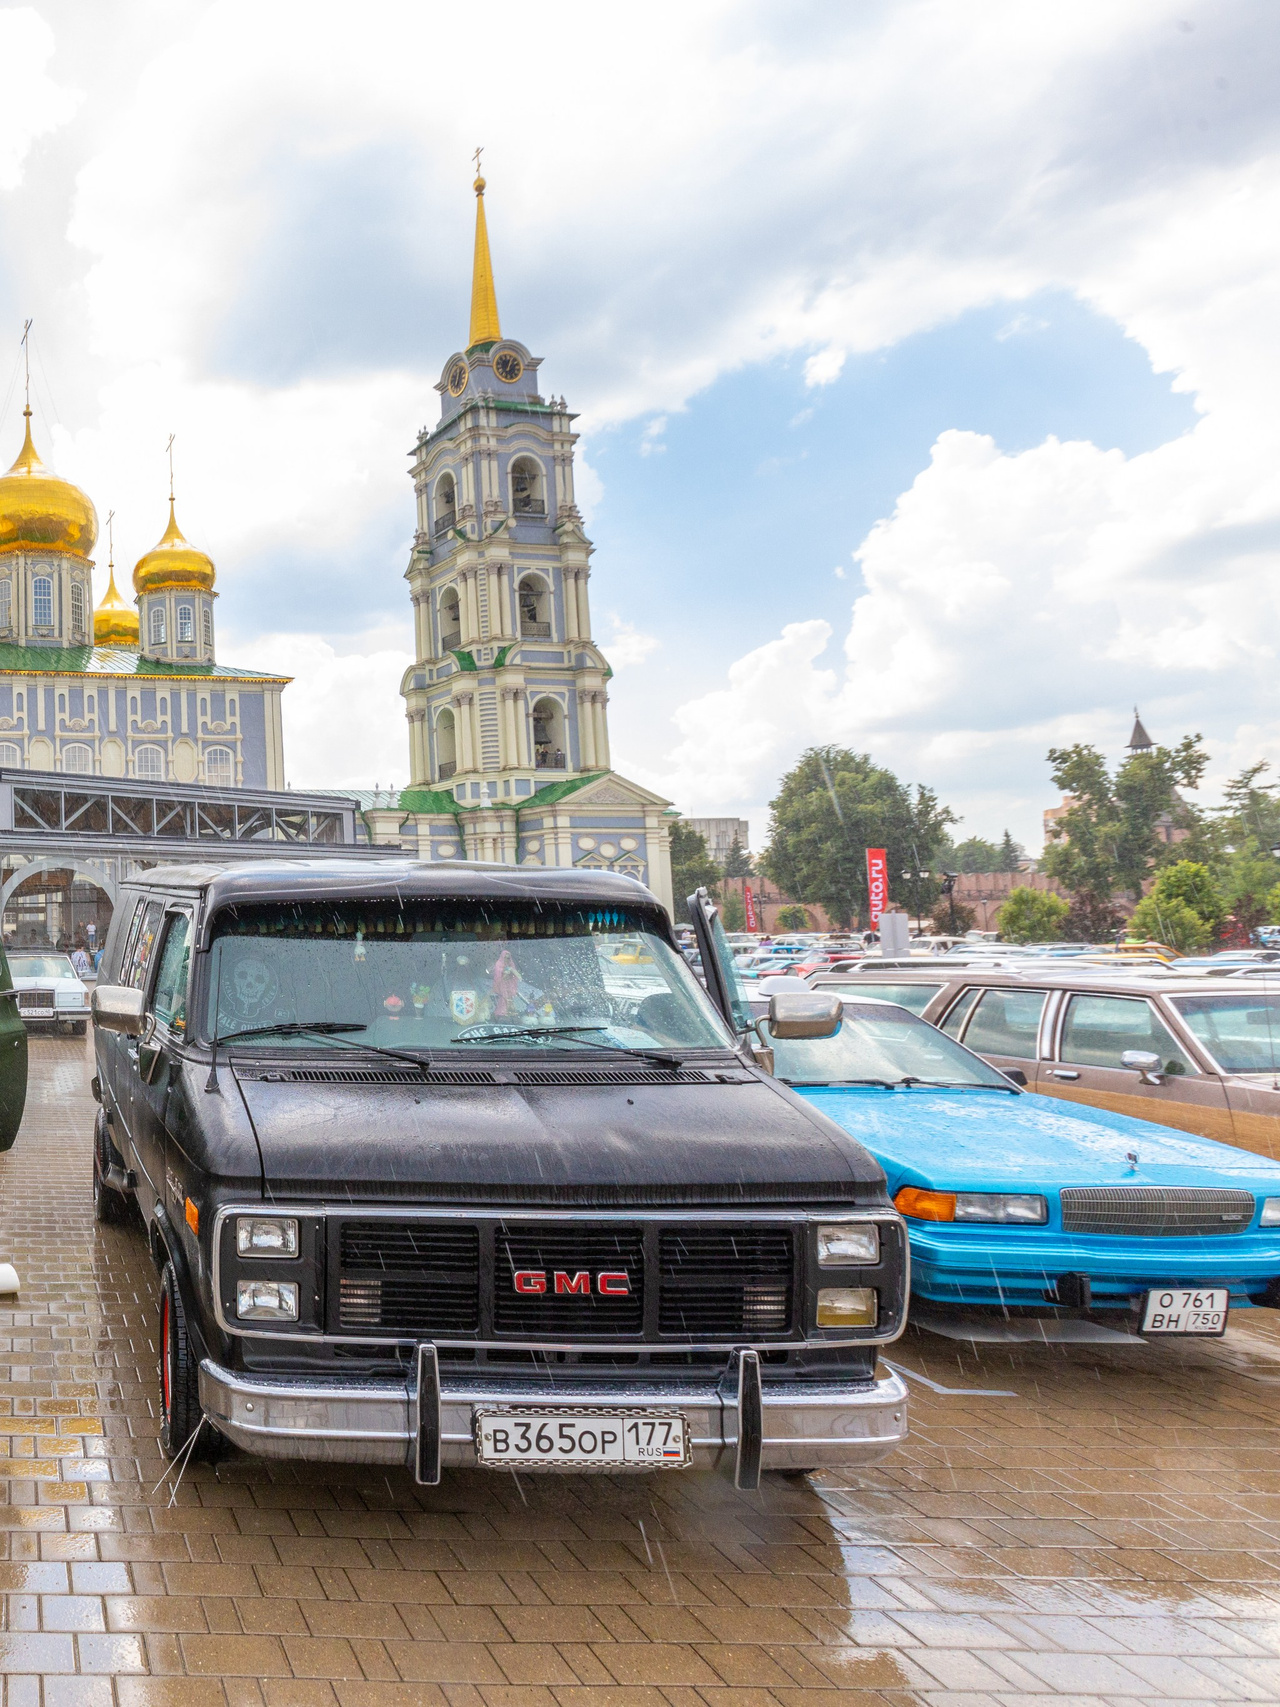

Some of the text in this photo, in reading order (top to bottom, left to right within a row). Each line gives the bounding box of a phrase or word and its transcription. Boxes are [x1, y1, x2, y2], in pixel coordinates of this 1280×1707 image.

[871, 859, 884, 923] auto.ru
[514, 1270, 629, 1295] GMC
[1182, 1292, 1214, 1309] 761
[1192, 1313, 1220, 1325] 750
[626, 1421, 673, 1446] 177
[638, 1447, 662, 1457] RUS
